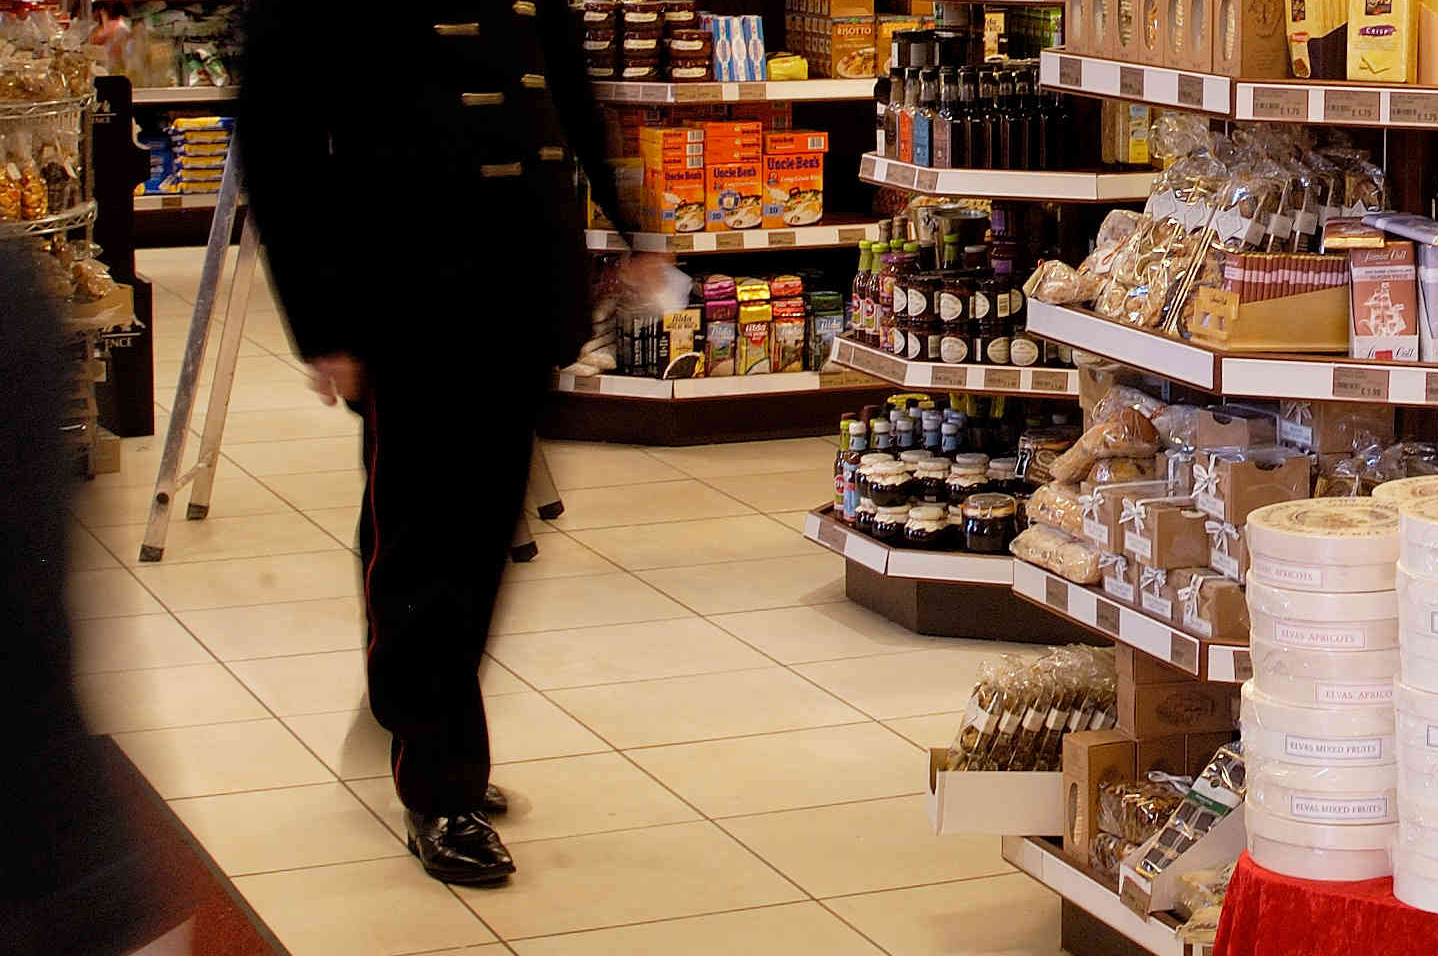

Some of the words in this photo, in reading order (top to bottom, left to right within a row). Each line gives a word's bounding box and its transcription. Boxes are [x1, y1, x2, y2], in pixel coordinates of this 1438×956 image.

[836, 25, 873, 37] RISOTTO
[768, 158, 794, 170] Uncle
[796, 157, 820, 168] Ben's
[665, 172, 684, 180] Uncle
[714, 168, 736, 178] Uncle
